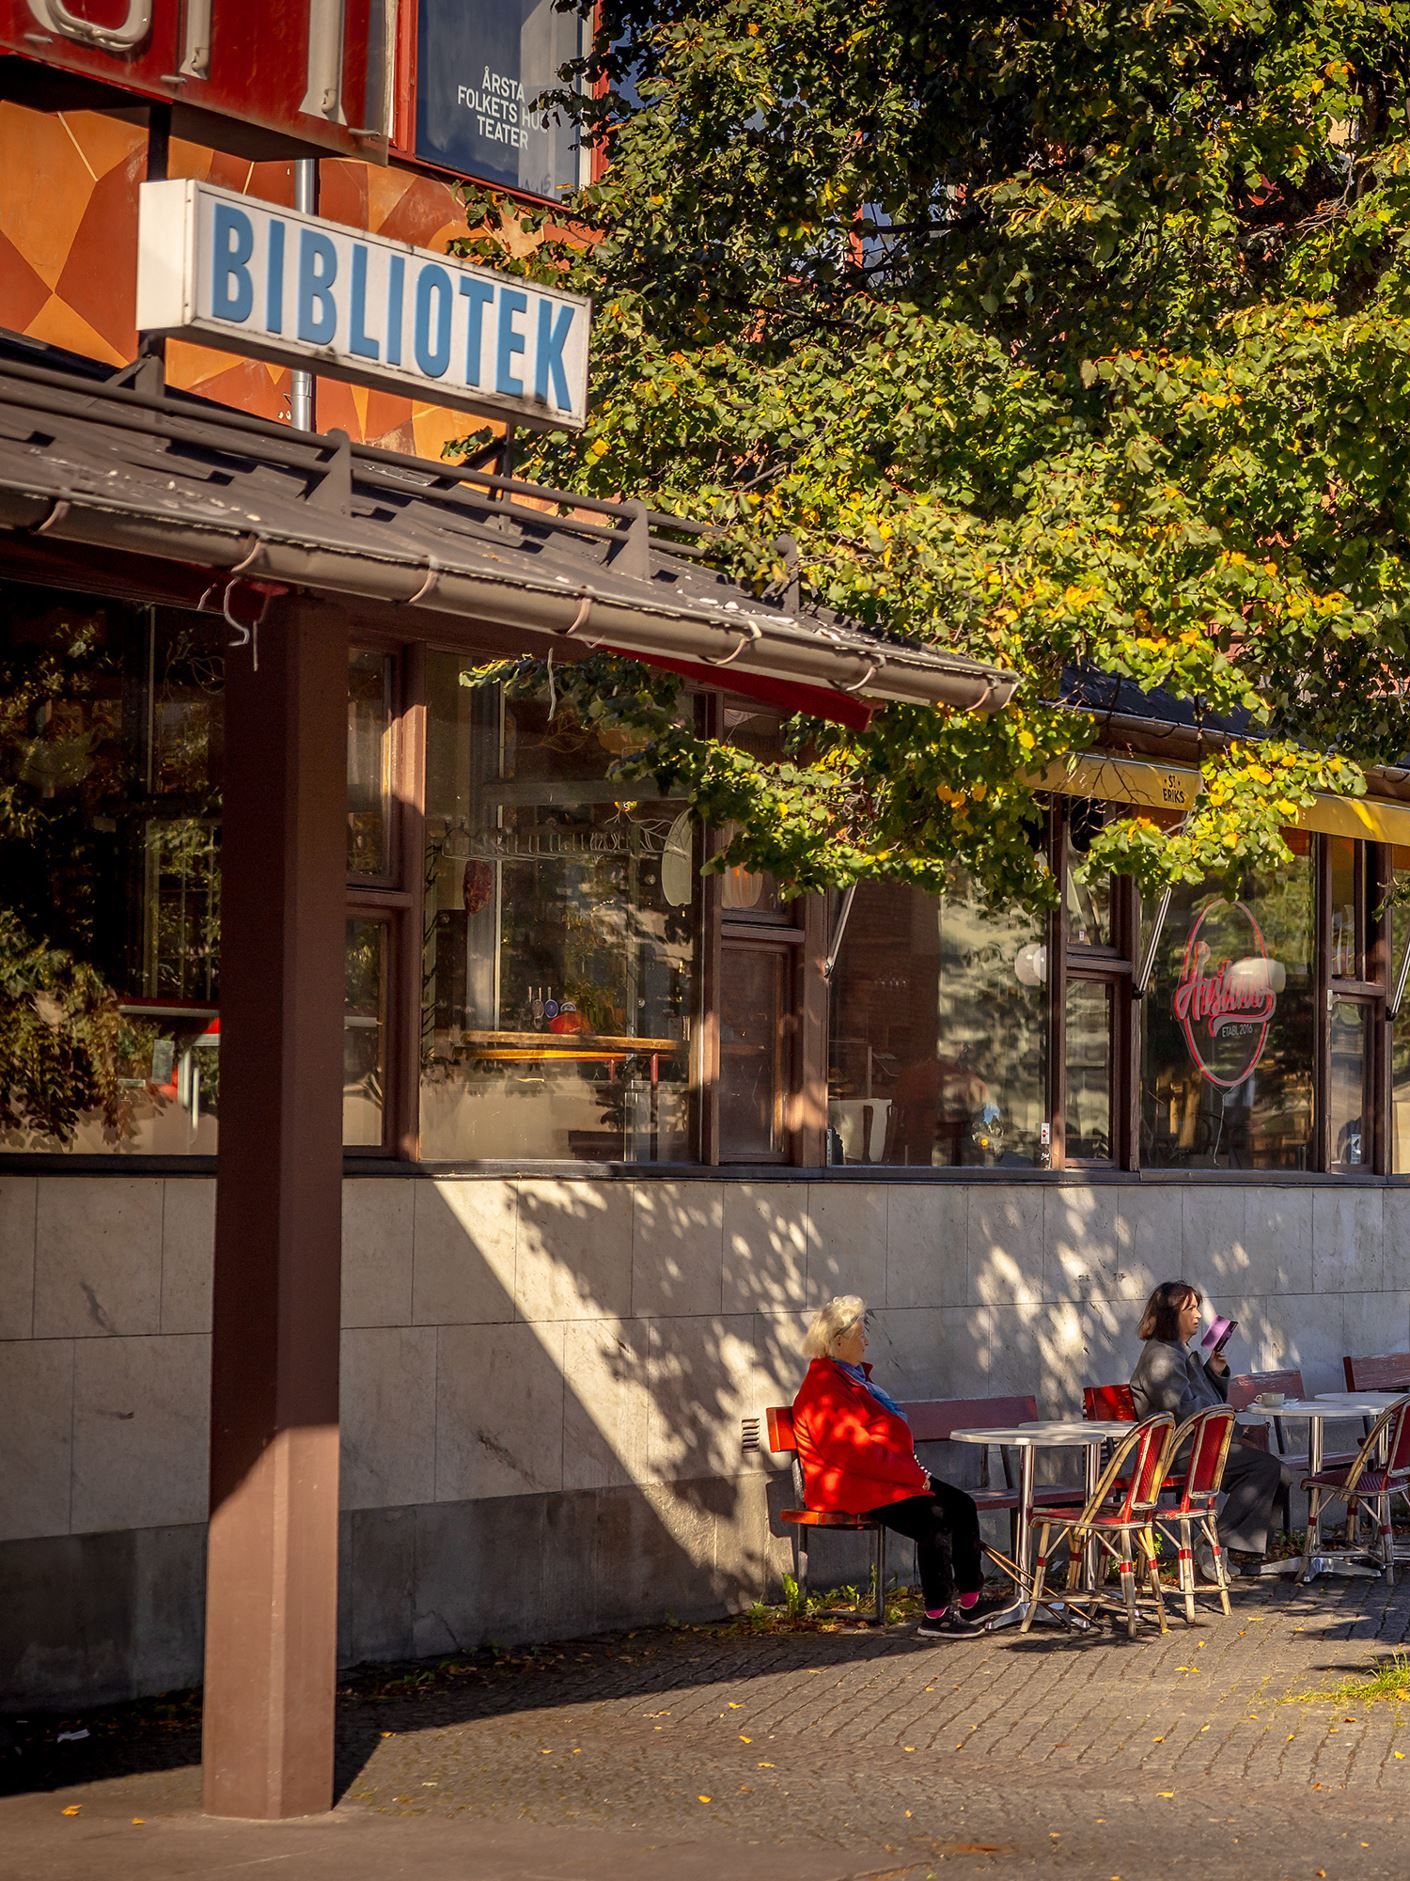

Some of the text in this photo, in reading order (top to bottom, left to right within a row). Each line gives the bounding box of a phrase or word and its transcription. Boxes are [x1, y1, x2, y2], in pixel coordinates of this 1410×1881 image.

[482, 65, 525, 103] ÅRSTA
[458, 85, 518, 123] FOLKETS
[477, 115, 529, 150] TEATER
[211, 203, 575, 412] BIBLIOTEK
[1163, 788, 1185, 803] ERIKS
